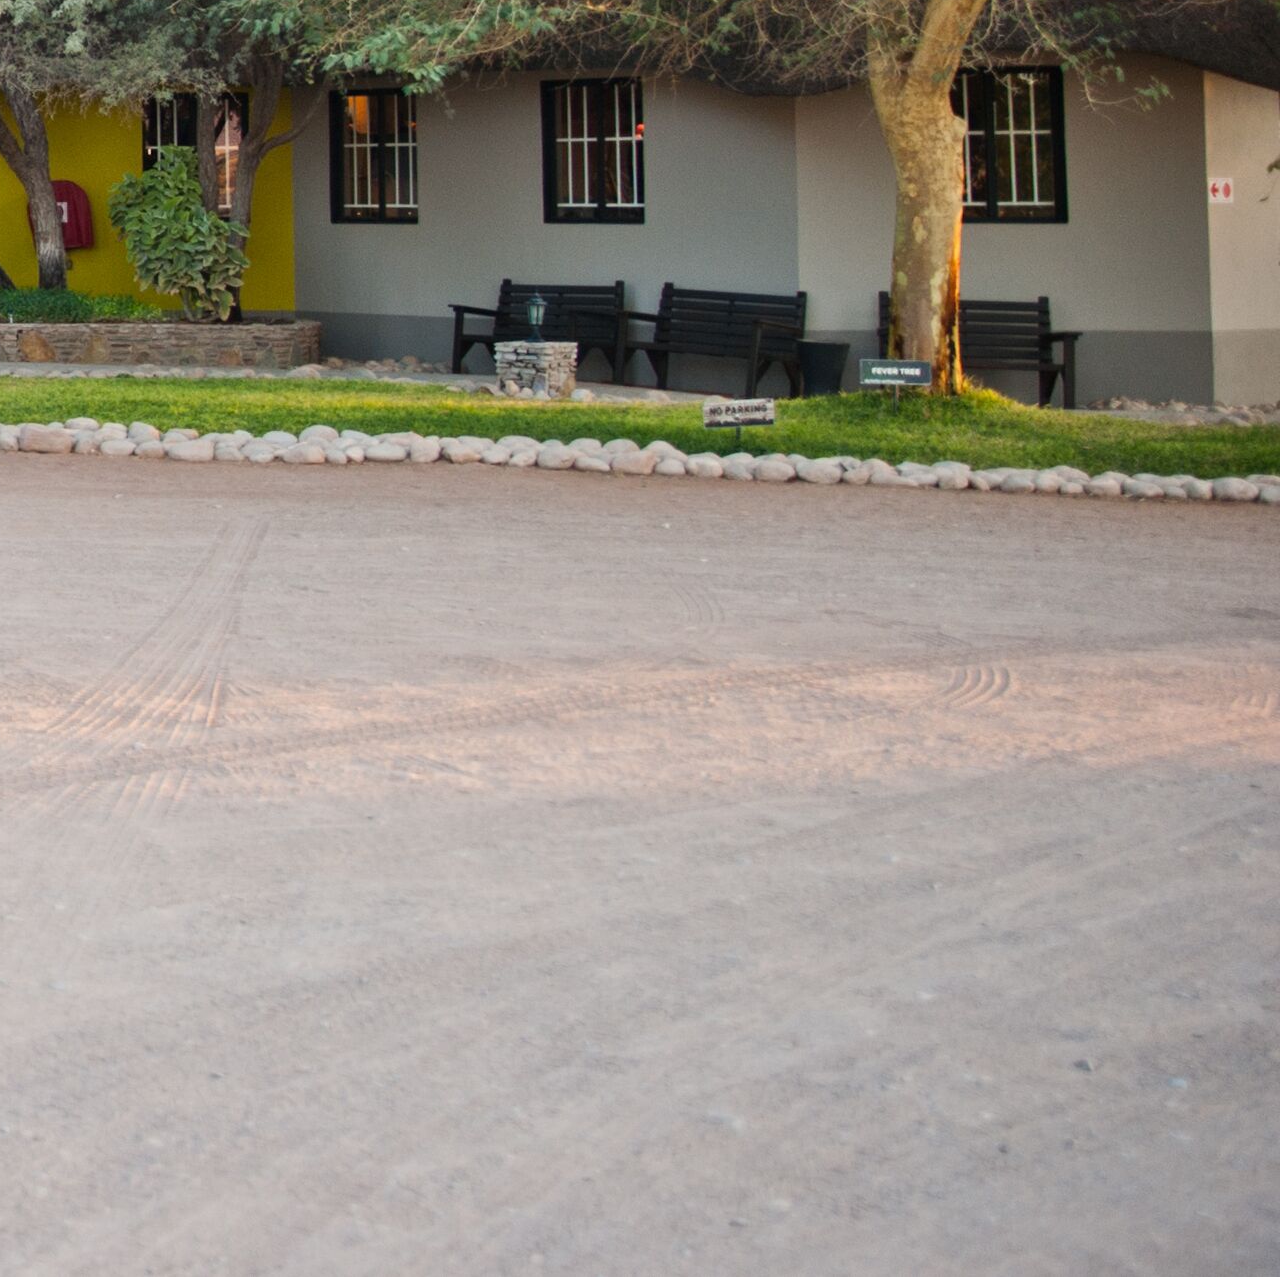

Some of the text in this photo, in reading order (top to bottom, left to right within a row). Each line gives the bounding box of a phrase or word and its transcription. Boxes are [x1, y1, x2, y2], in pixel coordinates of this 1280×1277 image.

[871, 367, 921, 376] FEVER TREE
[709, 404, 768, 417] NO PARKING
